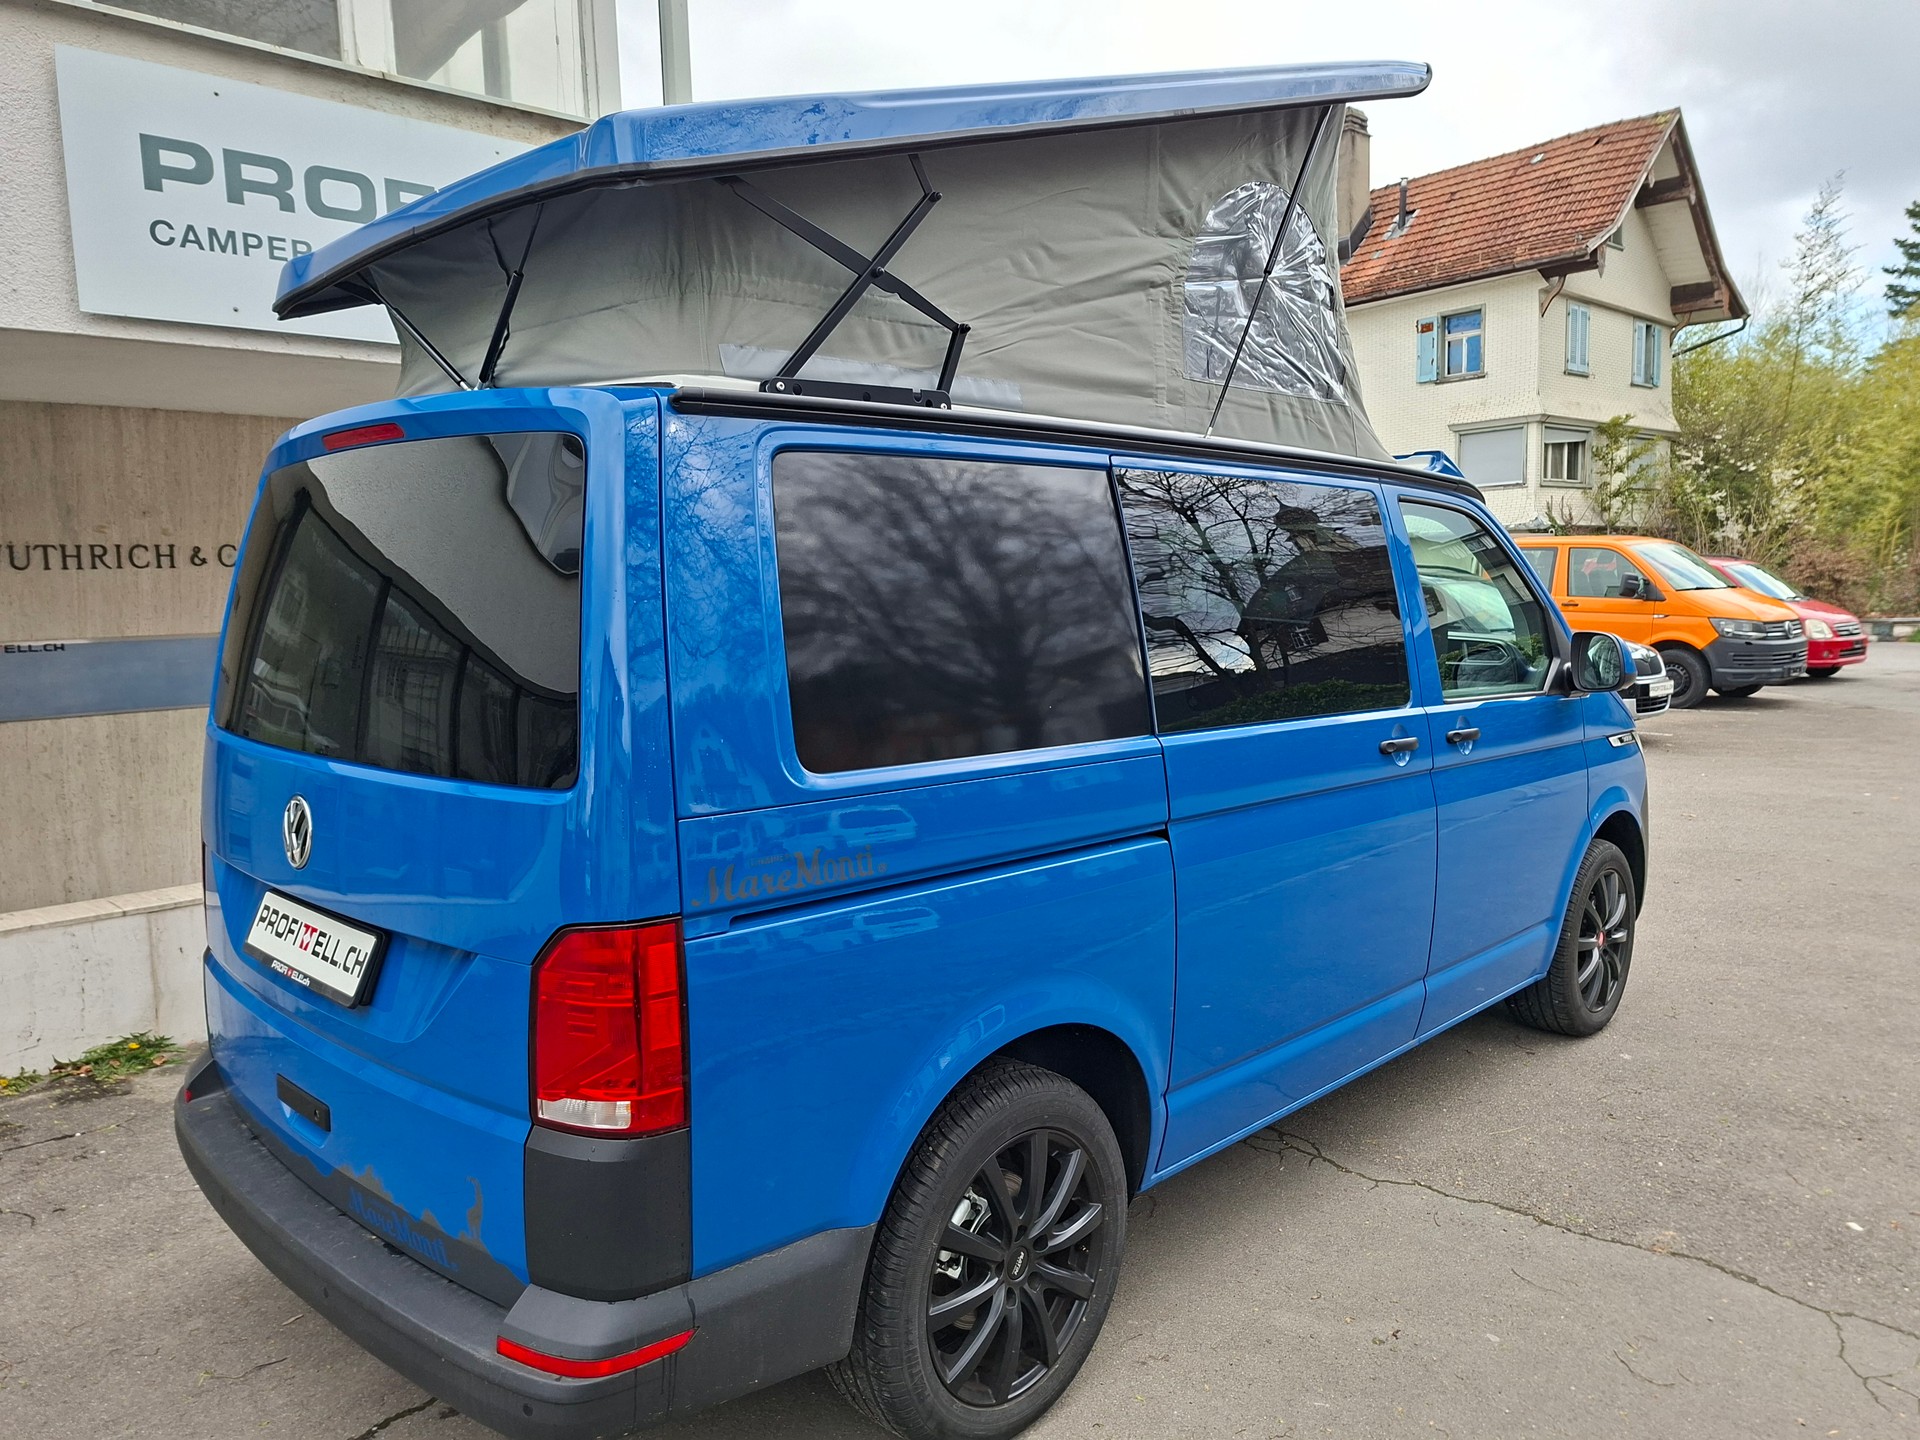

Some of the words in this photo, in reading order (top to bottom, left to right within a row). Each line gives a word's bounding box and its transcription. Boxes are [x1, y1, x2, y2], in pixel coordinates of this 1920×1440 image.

[0, 541, 176, 570] ÜTHRICH
[190, 546, 208, 566] &
[0, 643, 65, 653] ELL.CH
